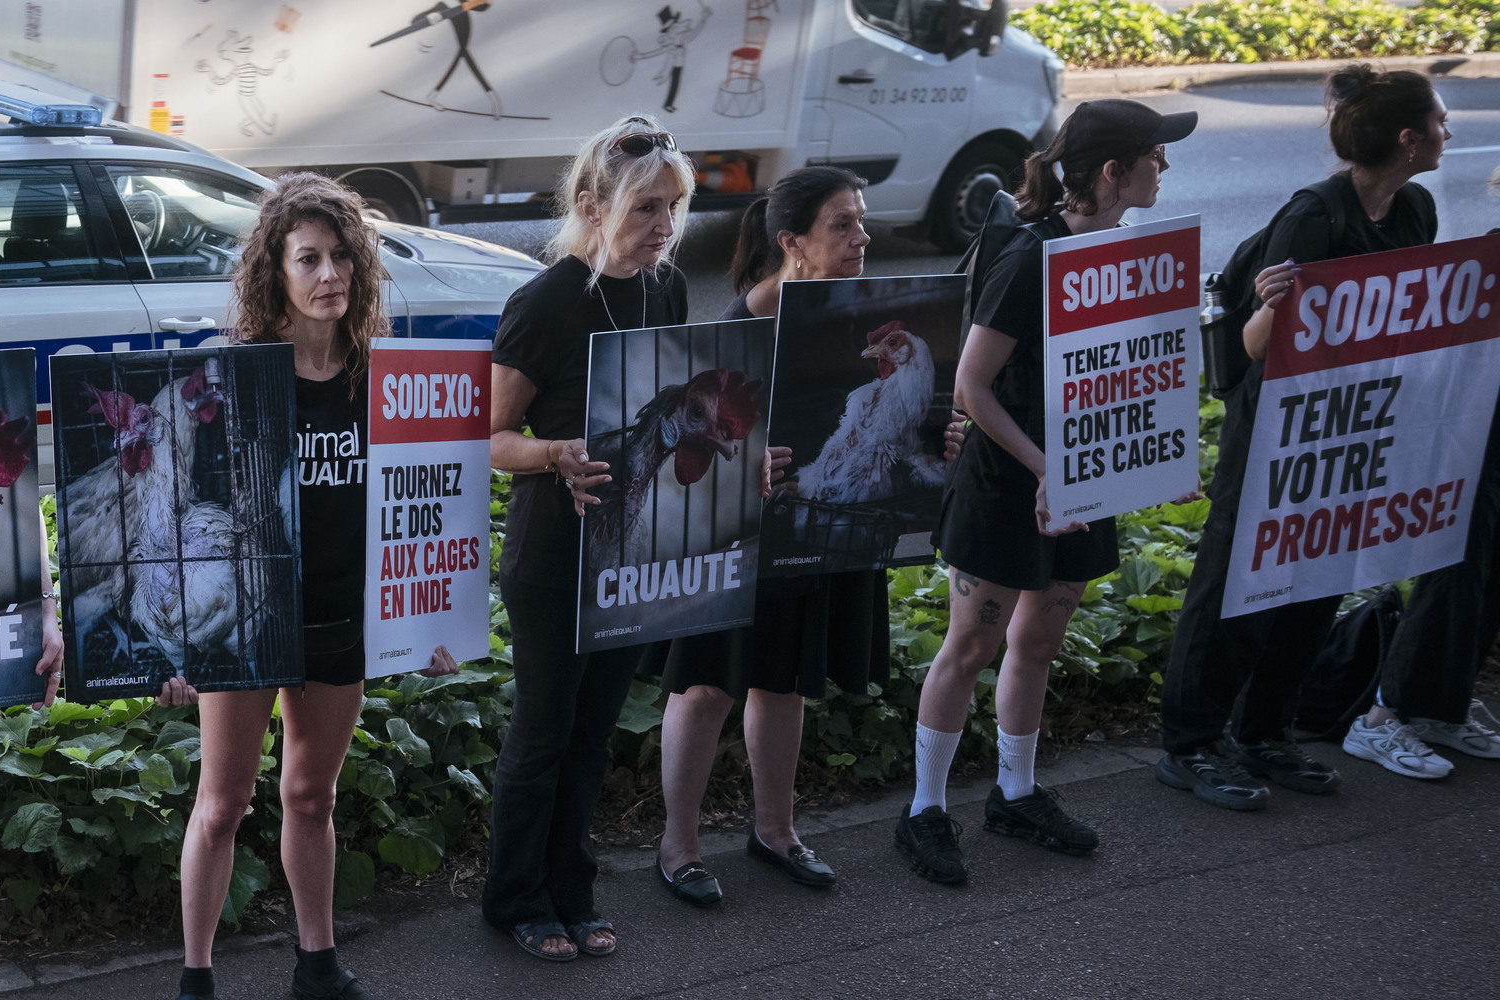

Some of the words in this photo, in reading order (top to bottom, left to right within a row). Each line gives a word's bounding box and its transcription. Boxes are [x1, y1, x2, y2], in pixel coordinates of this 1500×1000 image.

[869, 89, 886, 104] 01
[890, 88, 907, 104] 34
[911, 87, 927, 103] 92
[931, 87, 947, 103] 20
[950, 86, 967, 102] 00
[1062, 252, 1185, 312] SODEXO:
[1294, 259, 1496, 352] SODEXO:
[1063, 342, 1121, 377] TENEZ
[1126, 328, 1186, 363] VOTRE
[382, 373, 480, 420] SODEXO:
[1063, 357, 1186, 414] PROMESSE
[1063, 399, 1156, 450] CONTRE
[1279, 375, 1402, 448] TENEZ
[297, 422, 359, 458] imal
[1064, 447, 1105, 486] LES
[1112, 429, 1185, 473] CAGES
[298, 459, 367, 486] UALIT
[381, 463, 462, 501] TOURNEZ
[1268, 436, 1394, 510] VOTRE
[381, 505, 402, 541] LE
[409, 502, 443, 538] DOS
[1251, 478, 1465, 572] PROMESSE!
[380, 543, 417, 580] AUX
[424, 536, 480, 575] CAGES
[596, 541, 743, 609] CRUAUTÉ
[380, 582, 404, 620] EN
[411, 578, 452, 616] INDE
